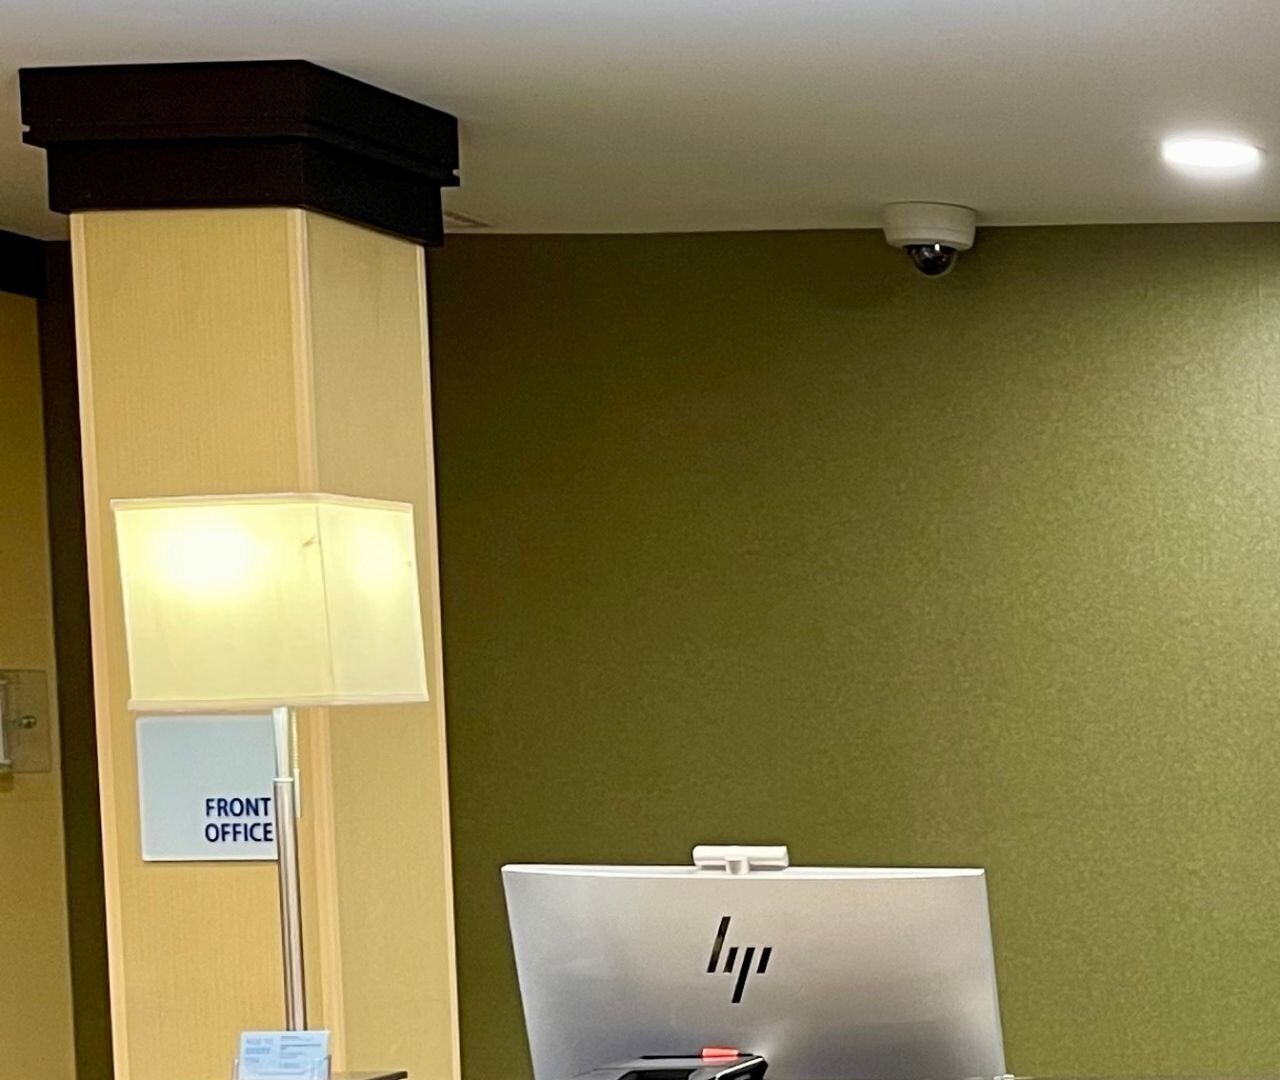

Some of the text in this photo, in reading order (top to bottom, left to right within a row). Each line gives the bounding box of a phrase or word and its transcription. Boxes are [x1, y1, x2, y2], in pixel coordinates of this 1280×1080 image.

[205, 797, 271, 817] FRONT
[205, 822, 273, 842] OFFICE
[706, 916, 772, 1004] hp
